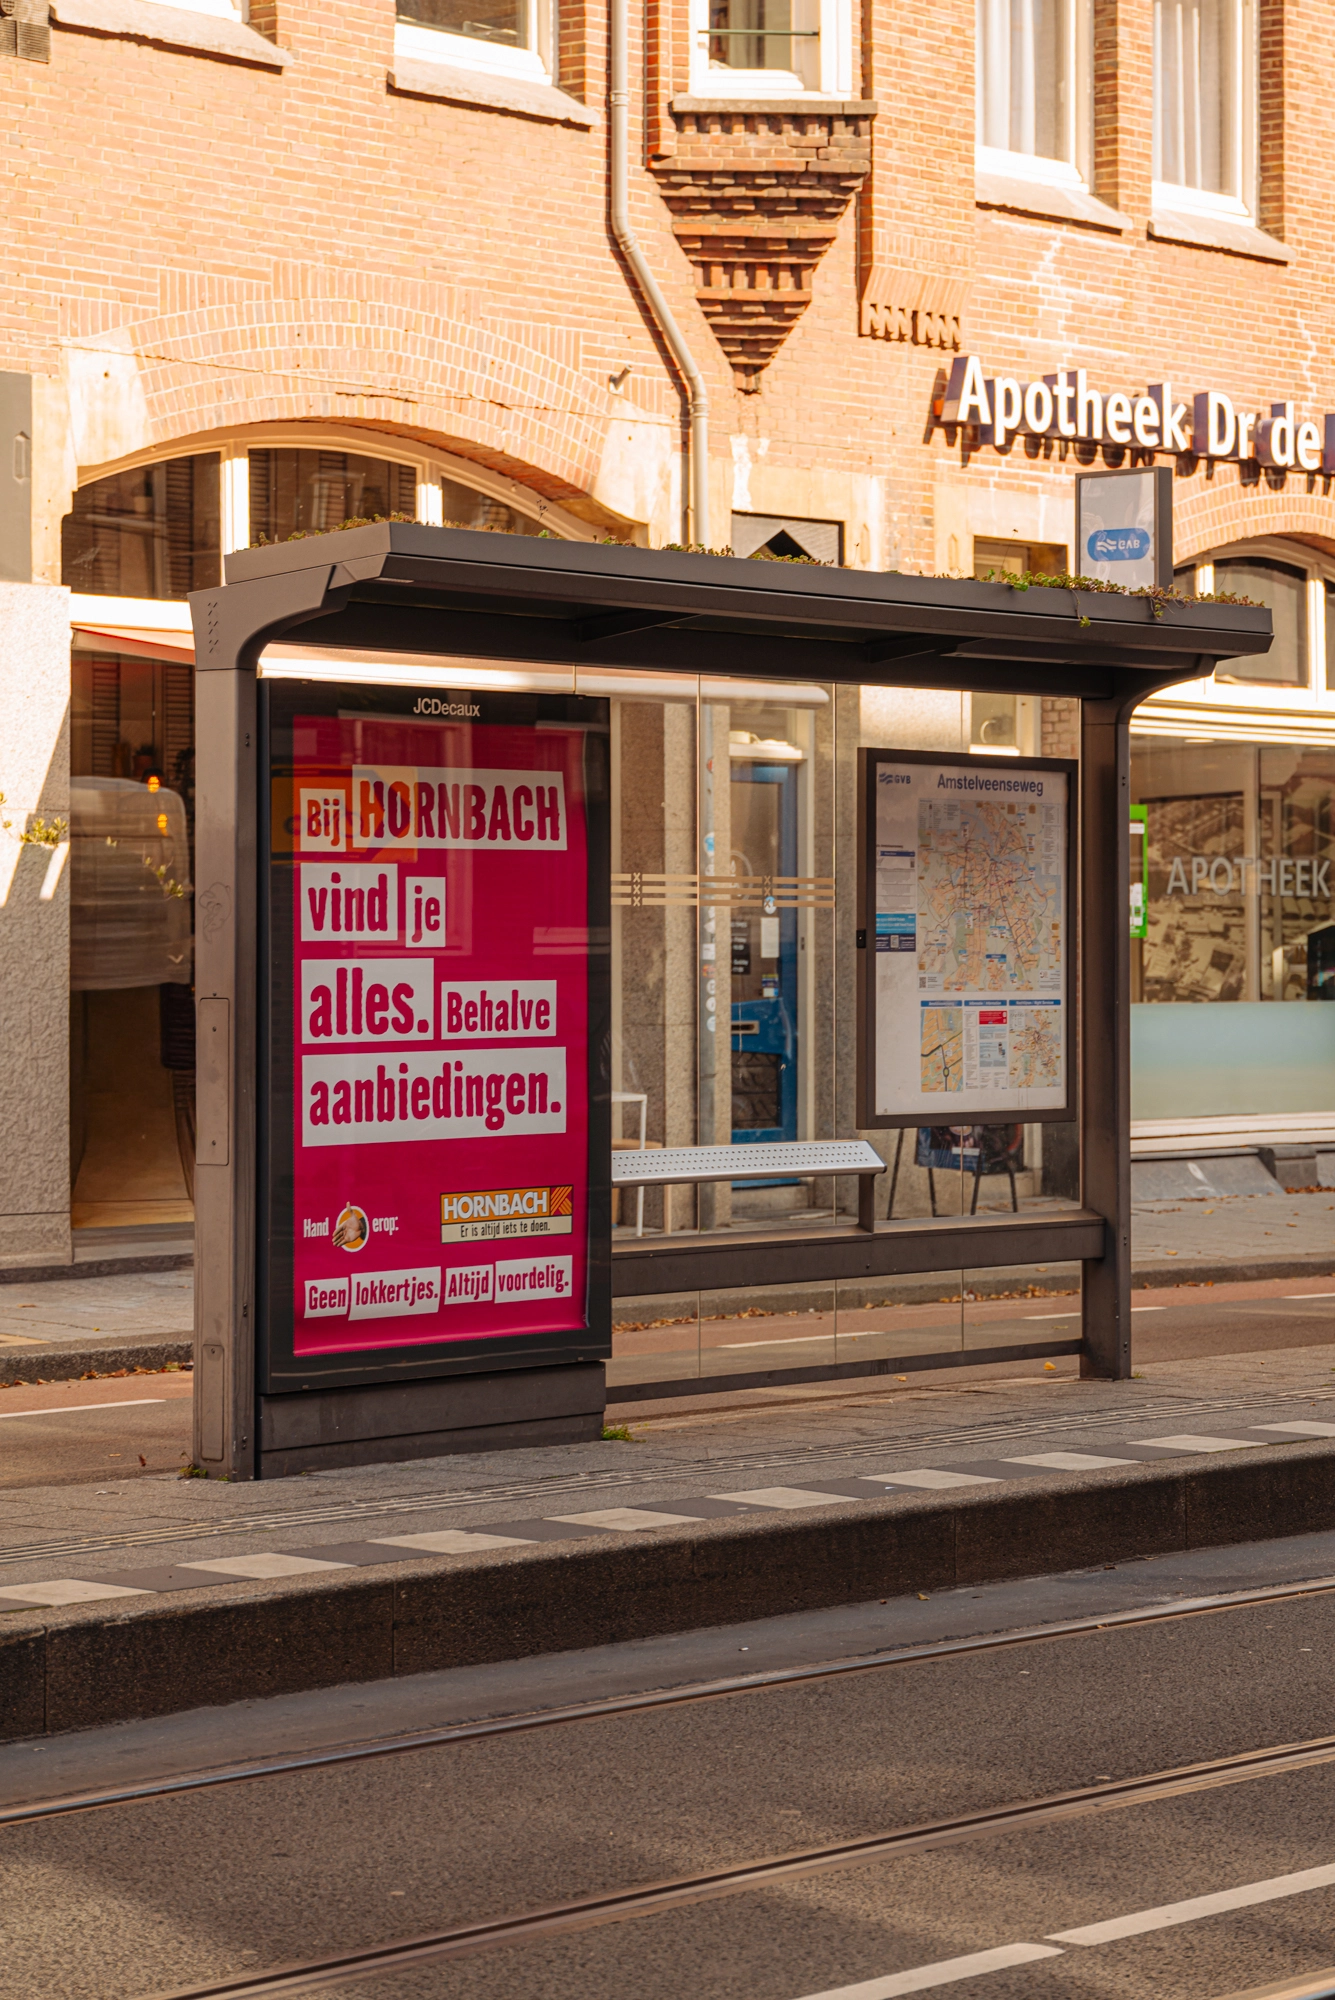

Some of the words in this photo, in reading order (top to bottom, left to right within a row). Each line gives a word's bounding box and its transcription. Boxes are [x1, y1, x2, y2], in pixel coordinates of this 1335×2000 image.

[956, 355, 1188, 452] Apotheek
[1207, 390, 1256, 460] Dr
[1269, 400, 1321, 470] de
[413, 697, 480, 717] JCDecaux
[895, 774, 912, 785] GVB
[937, 773, 1044, 797] Amstelveenseweg
[306, 798, 341, 847] Bij
[359, 780, 560, 842] HORNBACH
[1166, 856, 1331, 898] APOTHEEK
[308, 871, 388, 932] vind
[411, 885, 441, 944] je
[309, 966, 430, 1038] alles.
[446, 989, 551, 1034] Behalve
[309, 1060, 562, 1131] aanbiedingen.
[443, 1190, 548, 1220] HORNBACH
[303, 1217, 329, 1238] Hand
[372, 1215, 399, 1236] erop:
[460, 1225, 469, 1238] Er
[471, 1223, 479, 1237] is
[480, 1222, 501, 1238] altijd
[502, 1221, 518, 1235] iets
[520, 1220, 528, 1233] te
[530, 1219, 551, 1232] doen.
[308, 1285, 347, 1311] Geen
[355, 1276, 439, 1307] lokkertjes.
[448, 1270, 489, 1300] Altijd
[498, 1264, 569, 1294] voordelig.
